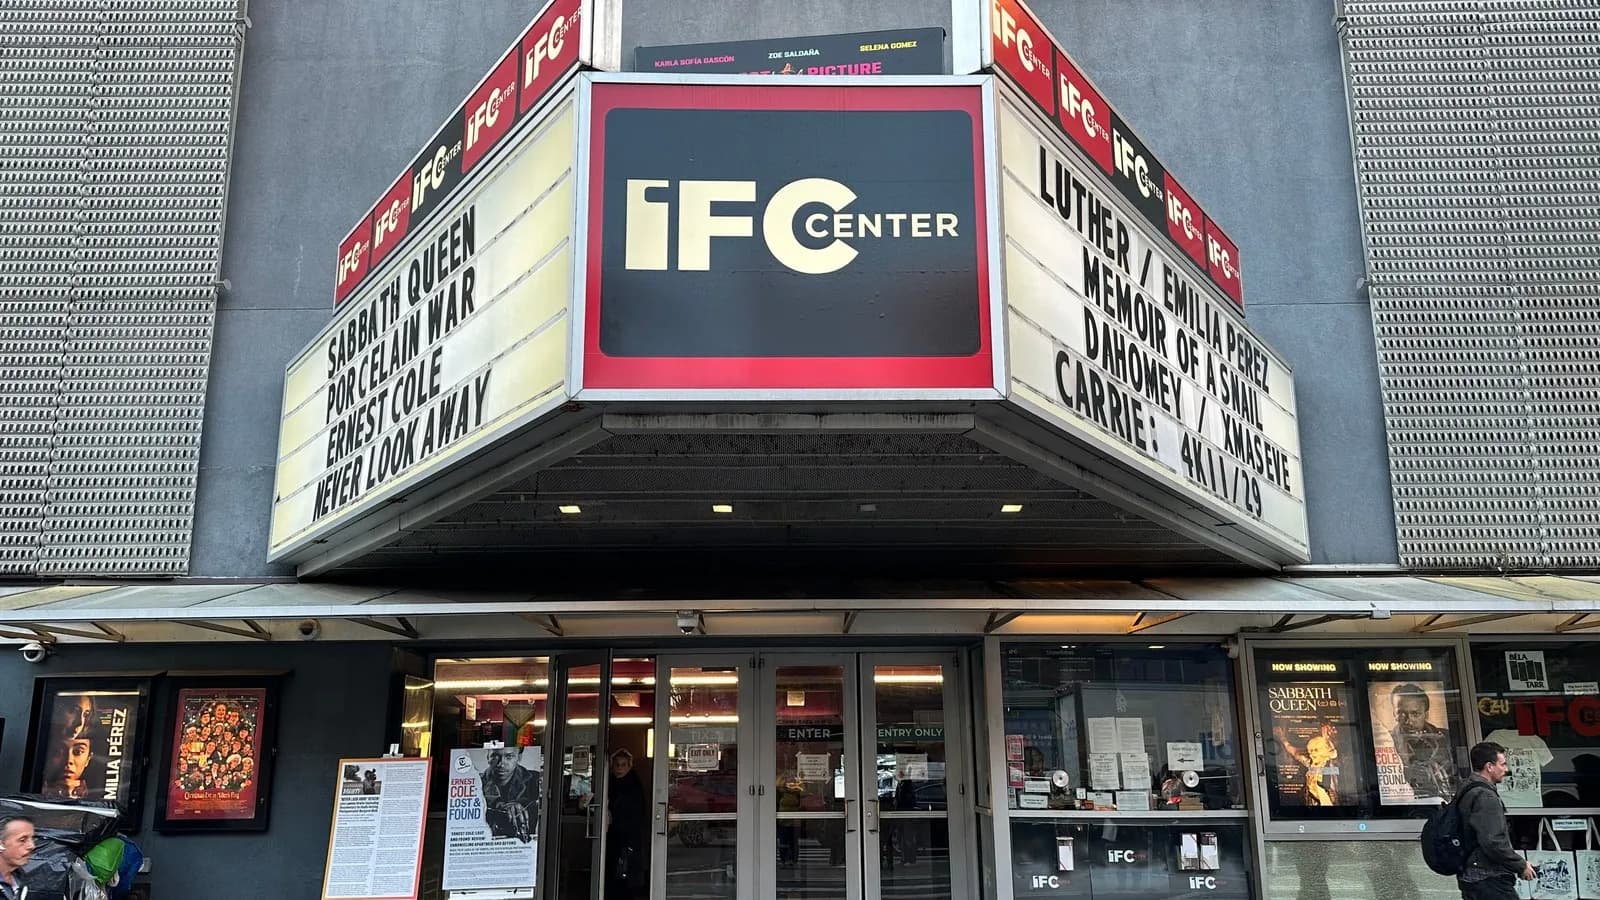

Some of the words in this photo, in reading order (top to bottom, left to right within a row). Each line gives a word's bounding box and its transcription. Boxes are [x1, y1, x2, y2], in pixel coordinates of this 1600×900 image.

[554, 6, 582, 43] CENTER
[784, 48, 820, 58] SALDAÑA
[859, 43, 890, 52] SELENA
[890, 40, 918, 50] GOMEZ
[654, 60, 678, 68] KARLA
[680, 57, 702, 66] SOFÍA
[703, 55, 735, 64] GASCÓN
[807, 62, 882, 75] PICTURE
[1023, 46, 1051, 80] CENTER
[491, 81, 515, 112] CENTER
[1087, 114, 1110, 143] CENTER
[437, 140, 462, 172] CENTER
[1141, 171, 1164, 202] CENTER
[805, 213, 960, 239] CENTER
[1039, 144, 1130, 275] LUTHER
[1140, 247, 1152, 288] /
[1163, 262, 1223, 355] EMILIA
[1226, 321, 1270, 395] PEREZ
[327, 275, 400, 379] SABBATH
[407, 204, 476, 307] QUEEN
[325, 309, 421, 424] PORCELAIN
[427, 265, 476, 346] WAR
[1083, 245, 1169, 360] MEMOIR
[1176, 327, 1199, 380] OF
[1206, 351, 1217, 397] A
[1220, 362, 1264, 432] SNAIL
[1083, 305, 1182, 420] DAHOMEY
[1198, 396, 1206, 433] /
[326, 387, 388, 468] ERNEST
[391, 346, 443, 424] COLE
[1056, 350, 1158, 453] CARRIE:
[312, 455, 363, 522] NEVER
[365, 417, 420, 490] LOOK
[419, 368, 492, 459] AWAY
[1272, 663, 1293, 671] NOW
[1294, 663, 1336, 672] SHOWING
[1369, 662, 1389, 671] NOW
[1390, 662, 1432, 671] SHOWING
[1268, 687, 1331, 699] SABBATH
[1270, 699, 1317, 712] QUEEN
[106, 708, 128, 757] PÉREZ
[788, 728, 831, 739] ENTER
[878, 728, 911, 738] ENTRY
[914, 728, 943, 738] ONLY
[103, 758, 122, 800] MILIA
[450, 778, 475, 786] ERNEST
[1377, 765, 1396, 773] LOST
[450, 785, 477, 798] COLE:
[450, 799, 471, 808] LOST
[473, 798, 481, 807] &
[448, 808, 481, 821] FOUND
